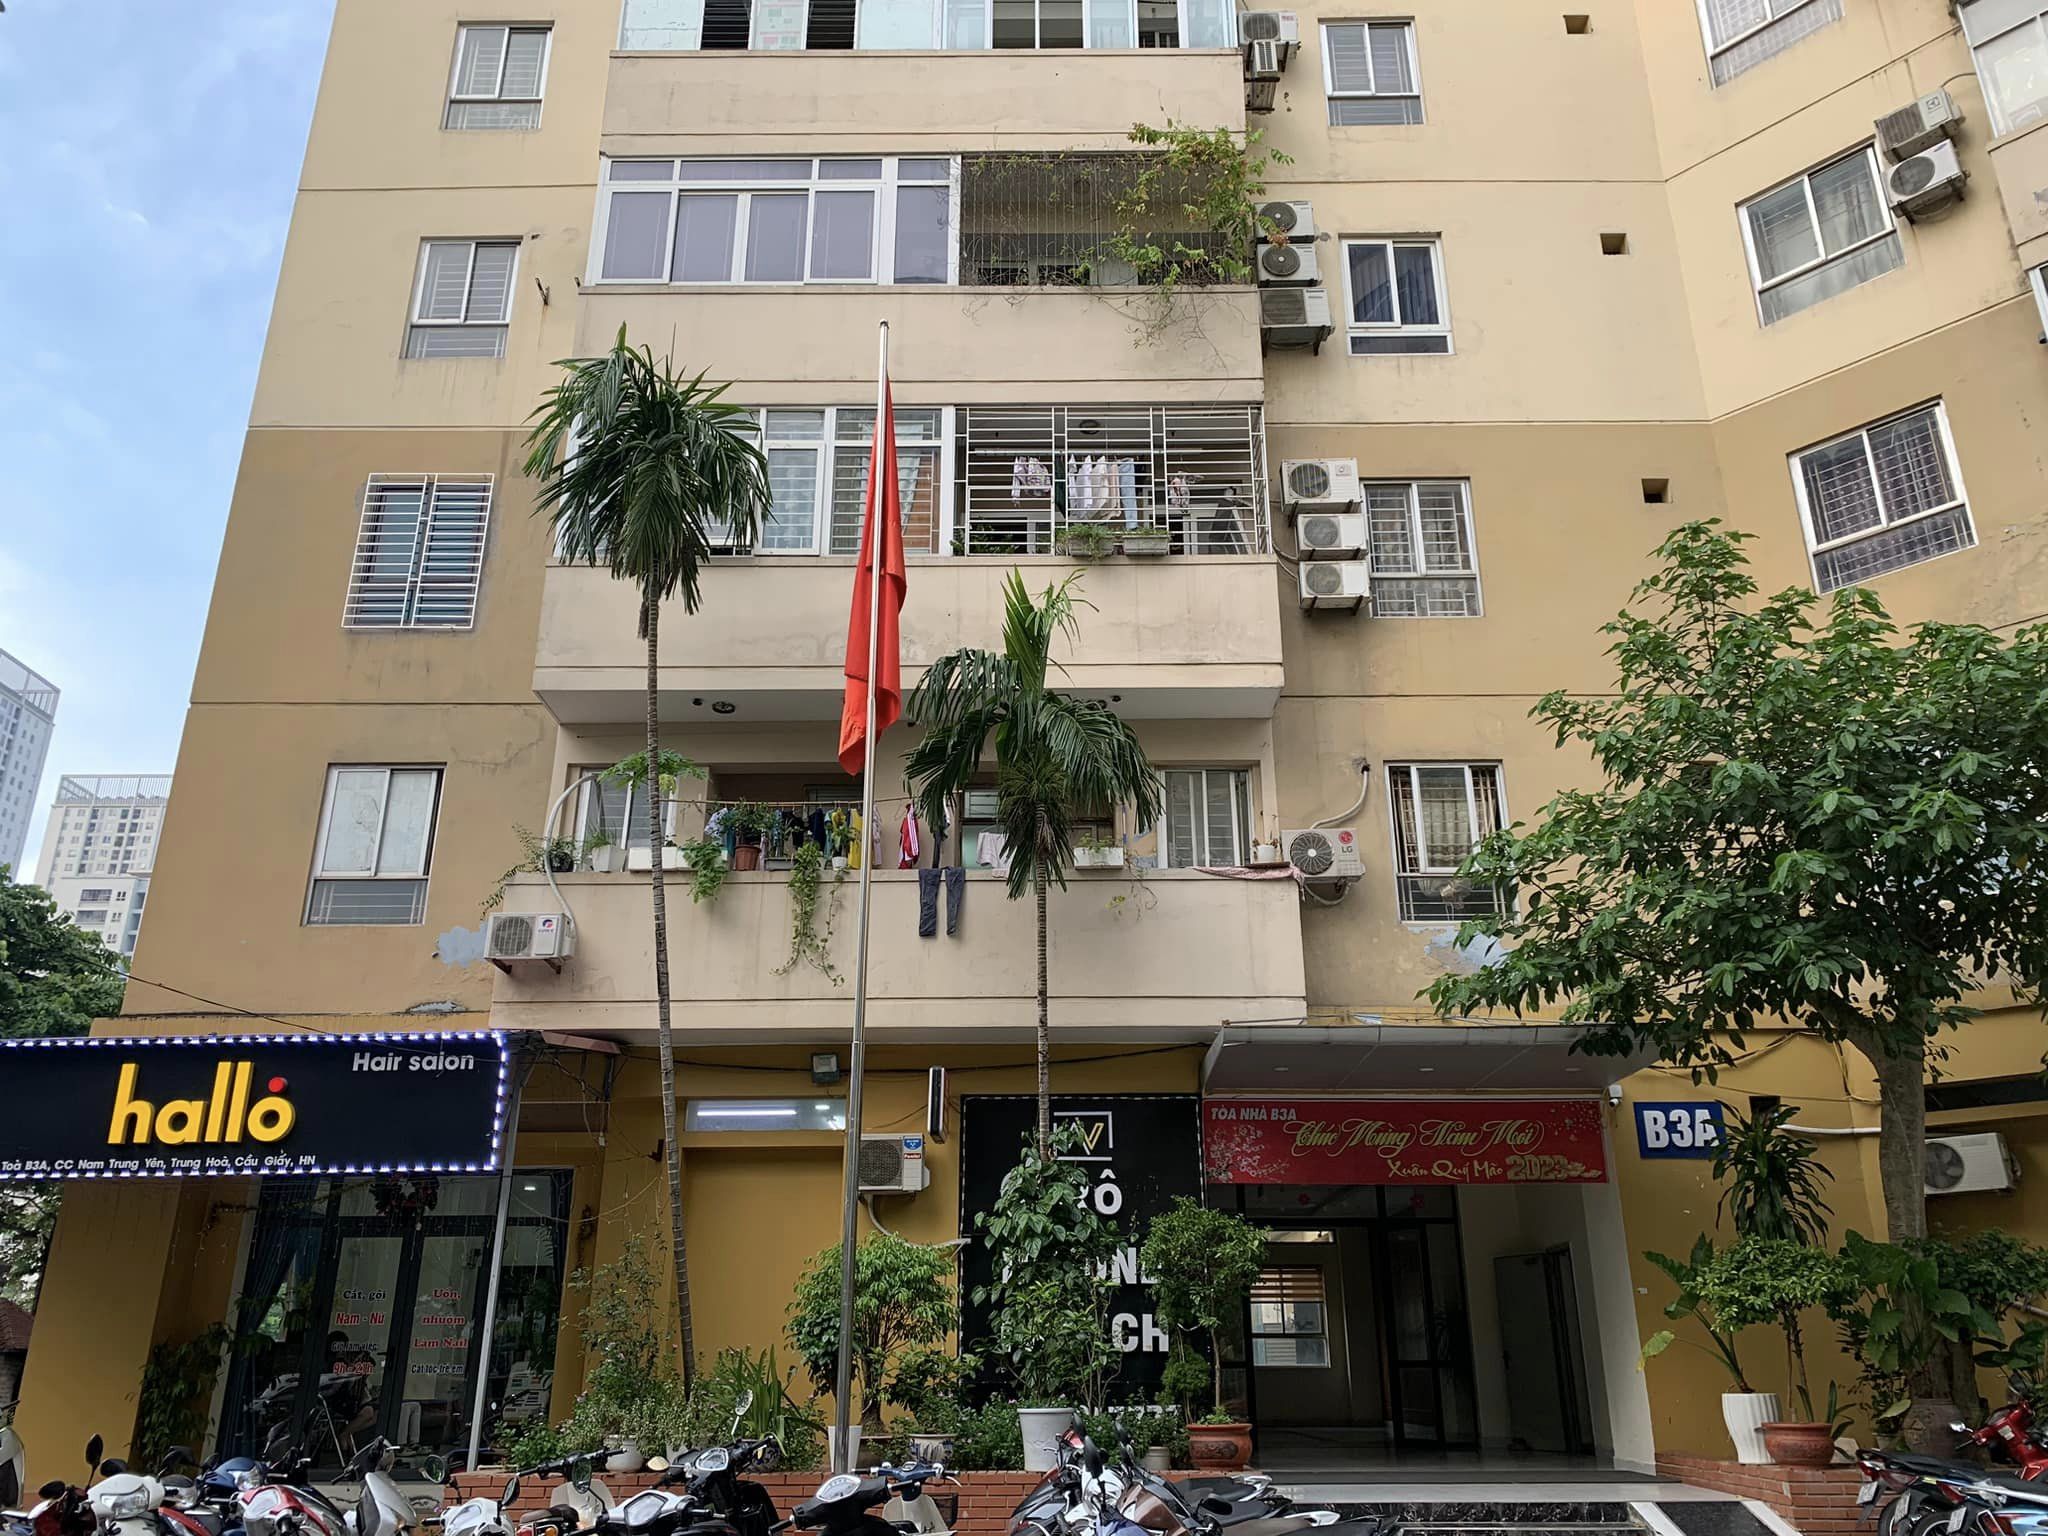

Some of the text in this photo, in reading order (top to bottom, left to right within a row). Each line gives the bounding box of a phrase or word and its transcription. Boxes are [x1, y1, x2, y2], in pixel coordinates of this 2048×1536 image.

[352, 1052, 402, 1071] Hair
[1211, 1104, 1297, 1120] TÒA NHÀ B3A
[1642, 1109, 1720, 1148] B3A
[25, 1160, 50, 1172] B3A,
[54, 1159, 74, 1170] CC
[78, 1159, 104, 1169] Nam
[108, 1158, 139, 1171] Trung
[144, 1157, 167, 1169] Yên,
[170, 1157, 201, 1169] Trung
[205, 1156, 231, 1168] Hoà,
[264, 1149, 294, 1168] Giấy,
[299, 1155, 316, 1166] HN
[1388, 1159, 1428, 1178] Xuân
[1431, 1159, 1470, 1182] Quý
[1473, 1160, 1504, 1179] Mão
[336, 1312, 360, 1325] Nam
